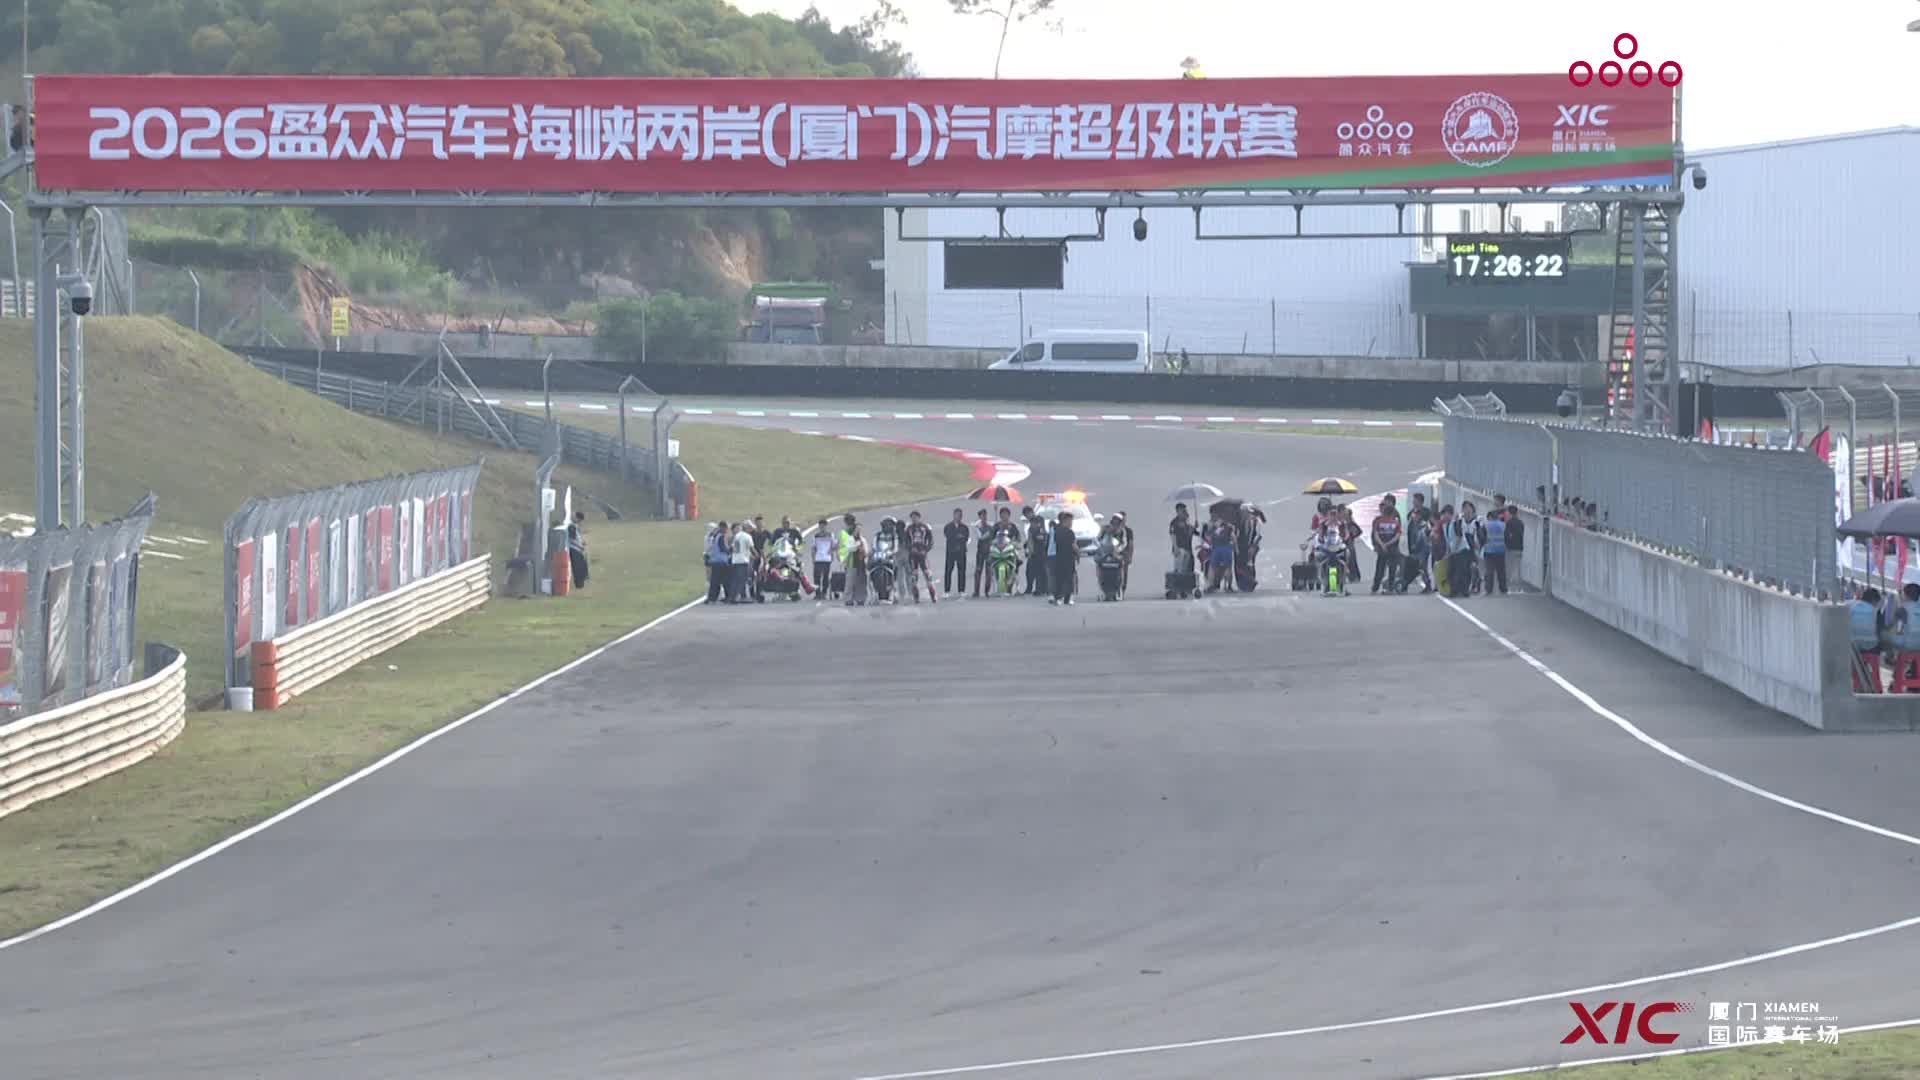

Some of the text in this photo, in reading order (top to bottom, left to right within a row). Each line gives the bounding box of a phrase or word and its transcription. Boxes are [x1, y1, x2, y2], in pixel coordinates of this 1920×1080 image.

[1553, 104, 1611, 127] XIC
[89, 102, 1298, 167] 2026盈众汽车海峡两岸(厦门)汽摩超级联赛
[1338, 142, 1412, 157] 盈众汽车
[1450, 242, 1475, 253] Local
[1454, 254, 1563, 277] 17:26:22
